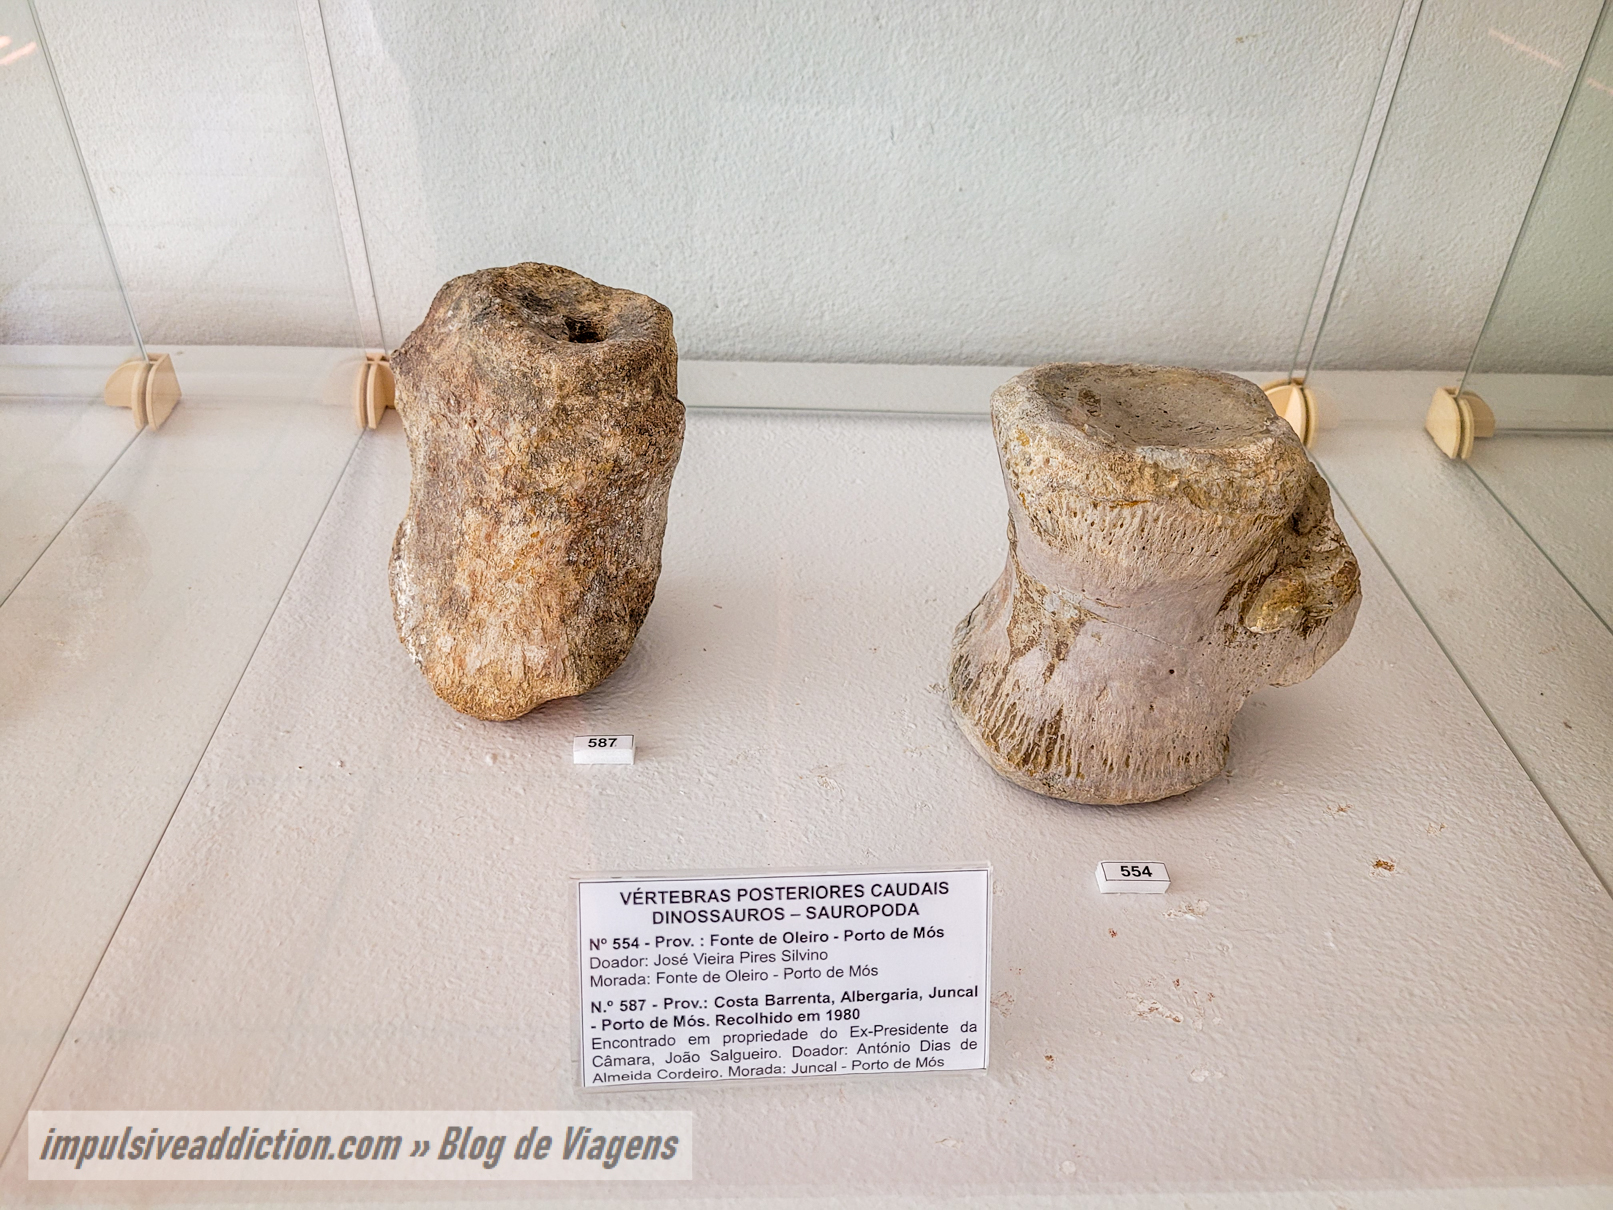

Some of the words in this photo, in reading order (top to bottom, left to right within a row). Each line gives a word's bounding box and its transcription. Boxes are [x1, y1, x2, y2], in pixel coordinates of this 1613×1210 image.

[588, 738, 618, 748] 587
[1120, 866, 1152, 877] 554
[620, 888, 731, 905] VÉRTEBRAS
[737, 884, 865, 902] POSTERIORES
[871, 882, 949, 897] CAUDAIS
[653, 907, 785, 924] DINOSSAUROS
[806, 903, 919, 920] SAUROPODA
[589, 938, 607, 951] Nº
[613, 937, 639, 949] 554
[655, 936, 694, 948] Prov.
[710, 934, 754, 946] Fonte
[759, 933, 777, 945] de
[783, 931, 829, 944] Oleiro
[844, 928, 885, 941] Porto
[891, 928, 908, 939] de
[913, 926, 944, 939] Mós
[590, 956, 648, 969] Doador:
[654, 953, 688, 966] José
[693, 952, 734, 965] Vieira
[740, 951, 776, 963] Pires
[781, 949, 828, 962] Silvino
[590, 973, 650, 987] Morada:
[657, 972, 697, 984] Fonte
[703, 971, 721, 983] de
[726, 969, 768, 982] Oleiro
[784, 967, 821, 979] Porto
[827, 966, 844, 978] de
[849, 965, 878, 977] Mós
[591, 1000, 613, 1013] N.º
[620, 999, 646, 1012] 587
[664, 997, 707, 1010] Prov.:
[714, 996, 759, 1008] Costa
[766, 992, 835, 1006] Barrenta,
[841, 988, 922, 1004] Albergaria,
[929, 985, 978, 999] Juncal
[602, 1018, 644, 1031] Porto
[650, 1016, 668, 1029] de
[673, 1015, 710, 1027] Mós.
[716, 1012, 792, 1026] Recolhido
[798, 1012, 820, 1022] em
[826, 1009, 860, 1021] 1980
[592, 1035, 676, 1050] Encontrado
[688, 1035, 710, 1045] em
[723, 1029, 808, 1046] propriedade
[820, 1027, 837, 1039] do
[850, 1022, 948, 1038] Ex-Presidente
[961, 1021, 977, 1033] da
[593, 1055, 654, 1068] Câmara,
[665, 1051, 700, 1065] João
[710, 1048, 781, 1063] Salgueiro.
[792, 1045, 847, 1058] Doador:
[857, 1042, 910, 1055] António
[920, 1040, 950, 1051] Dias
[961, 1038, 977, 1050] de
[593, 1070, 651, 1083] Almeida
[657, 1068, 722, 1080] Cordeiro.
[728, 1064, 786, 1077] Morada:
[792, 1061, 837, 1074] Juncal
[852, 1059, 889, 1070] Porto
[894, 1058, 910, 1069] de
[916, 1057, 944, 1068] Mós
